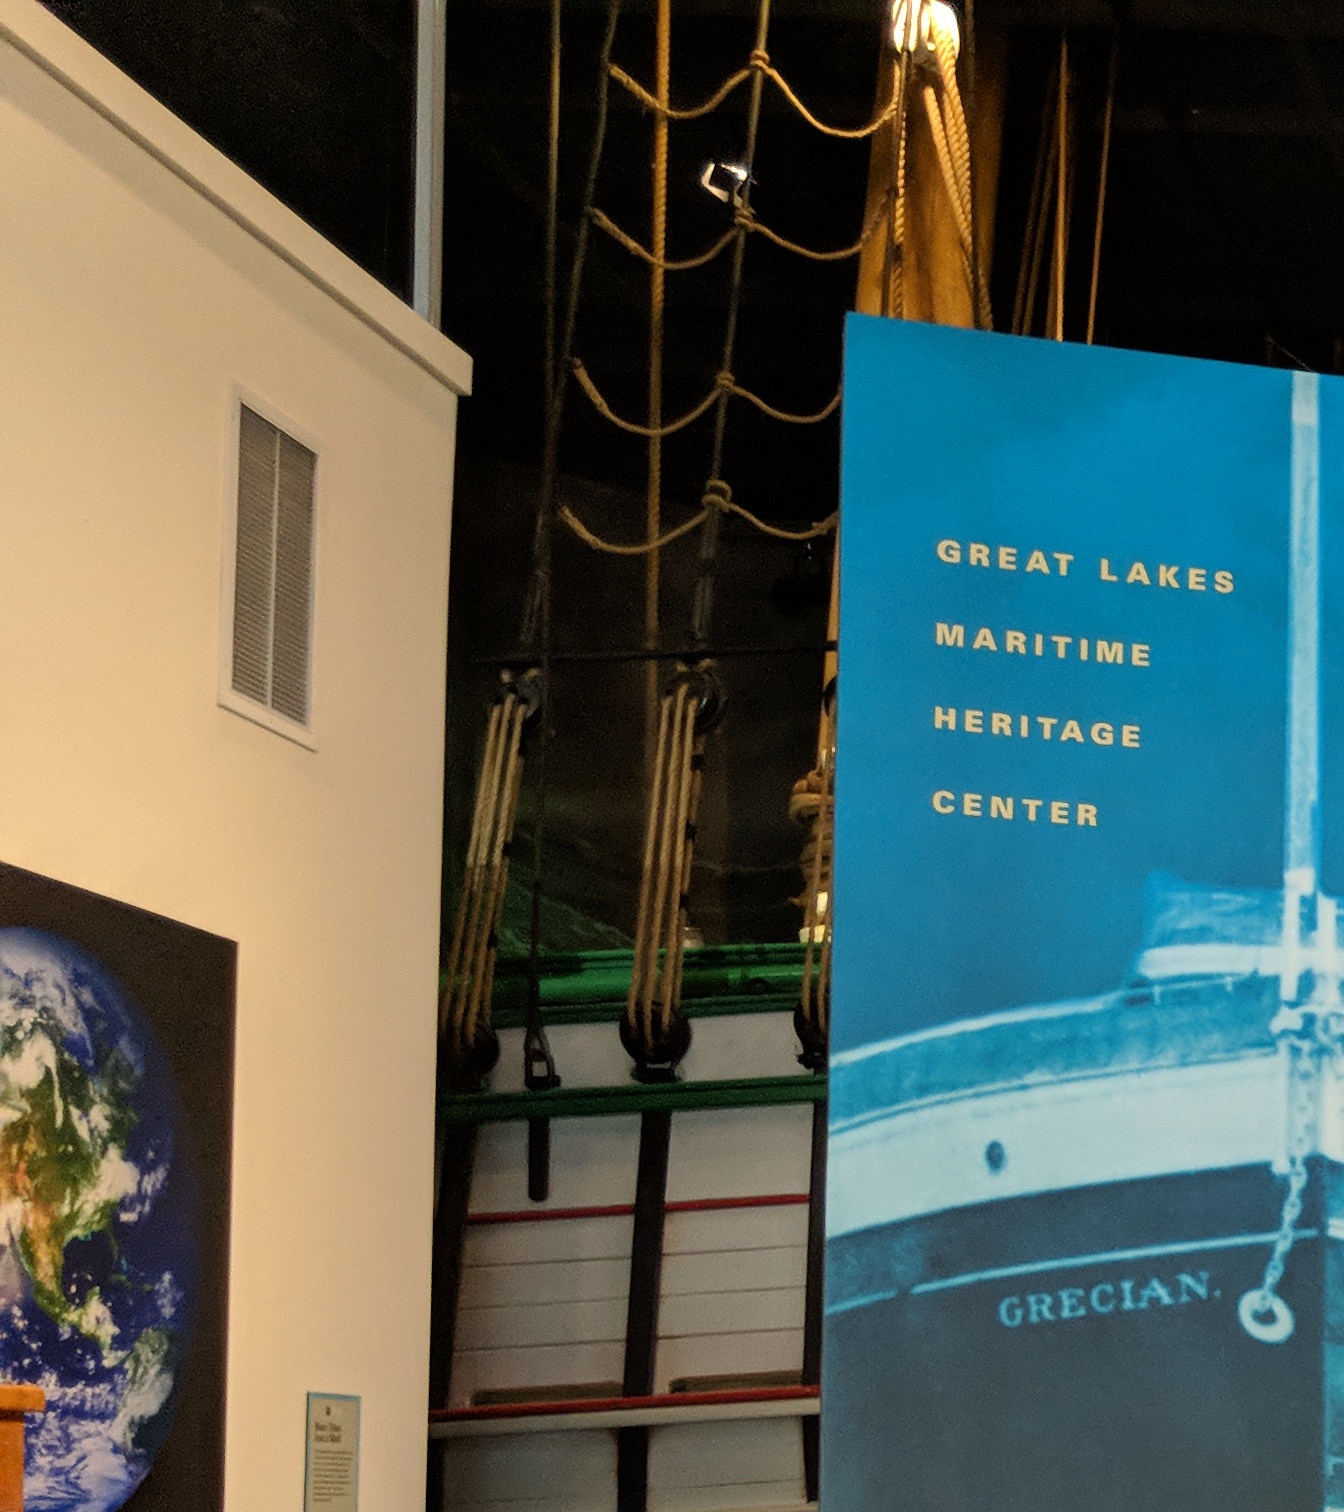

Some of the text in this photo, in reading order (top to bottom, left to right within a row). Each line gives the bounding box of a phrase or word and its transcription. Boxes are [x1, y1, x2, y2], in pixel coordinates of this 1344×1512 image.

[936, 538, 1235, 594] GREAT LAKES
[934, 621, 1150, 668] MARITIME
[933, 705, 1140, 749] HERITAGE
[931, 789, 1098, 827] CENTER
